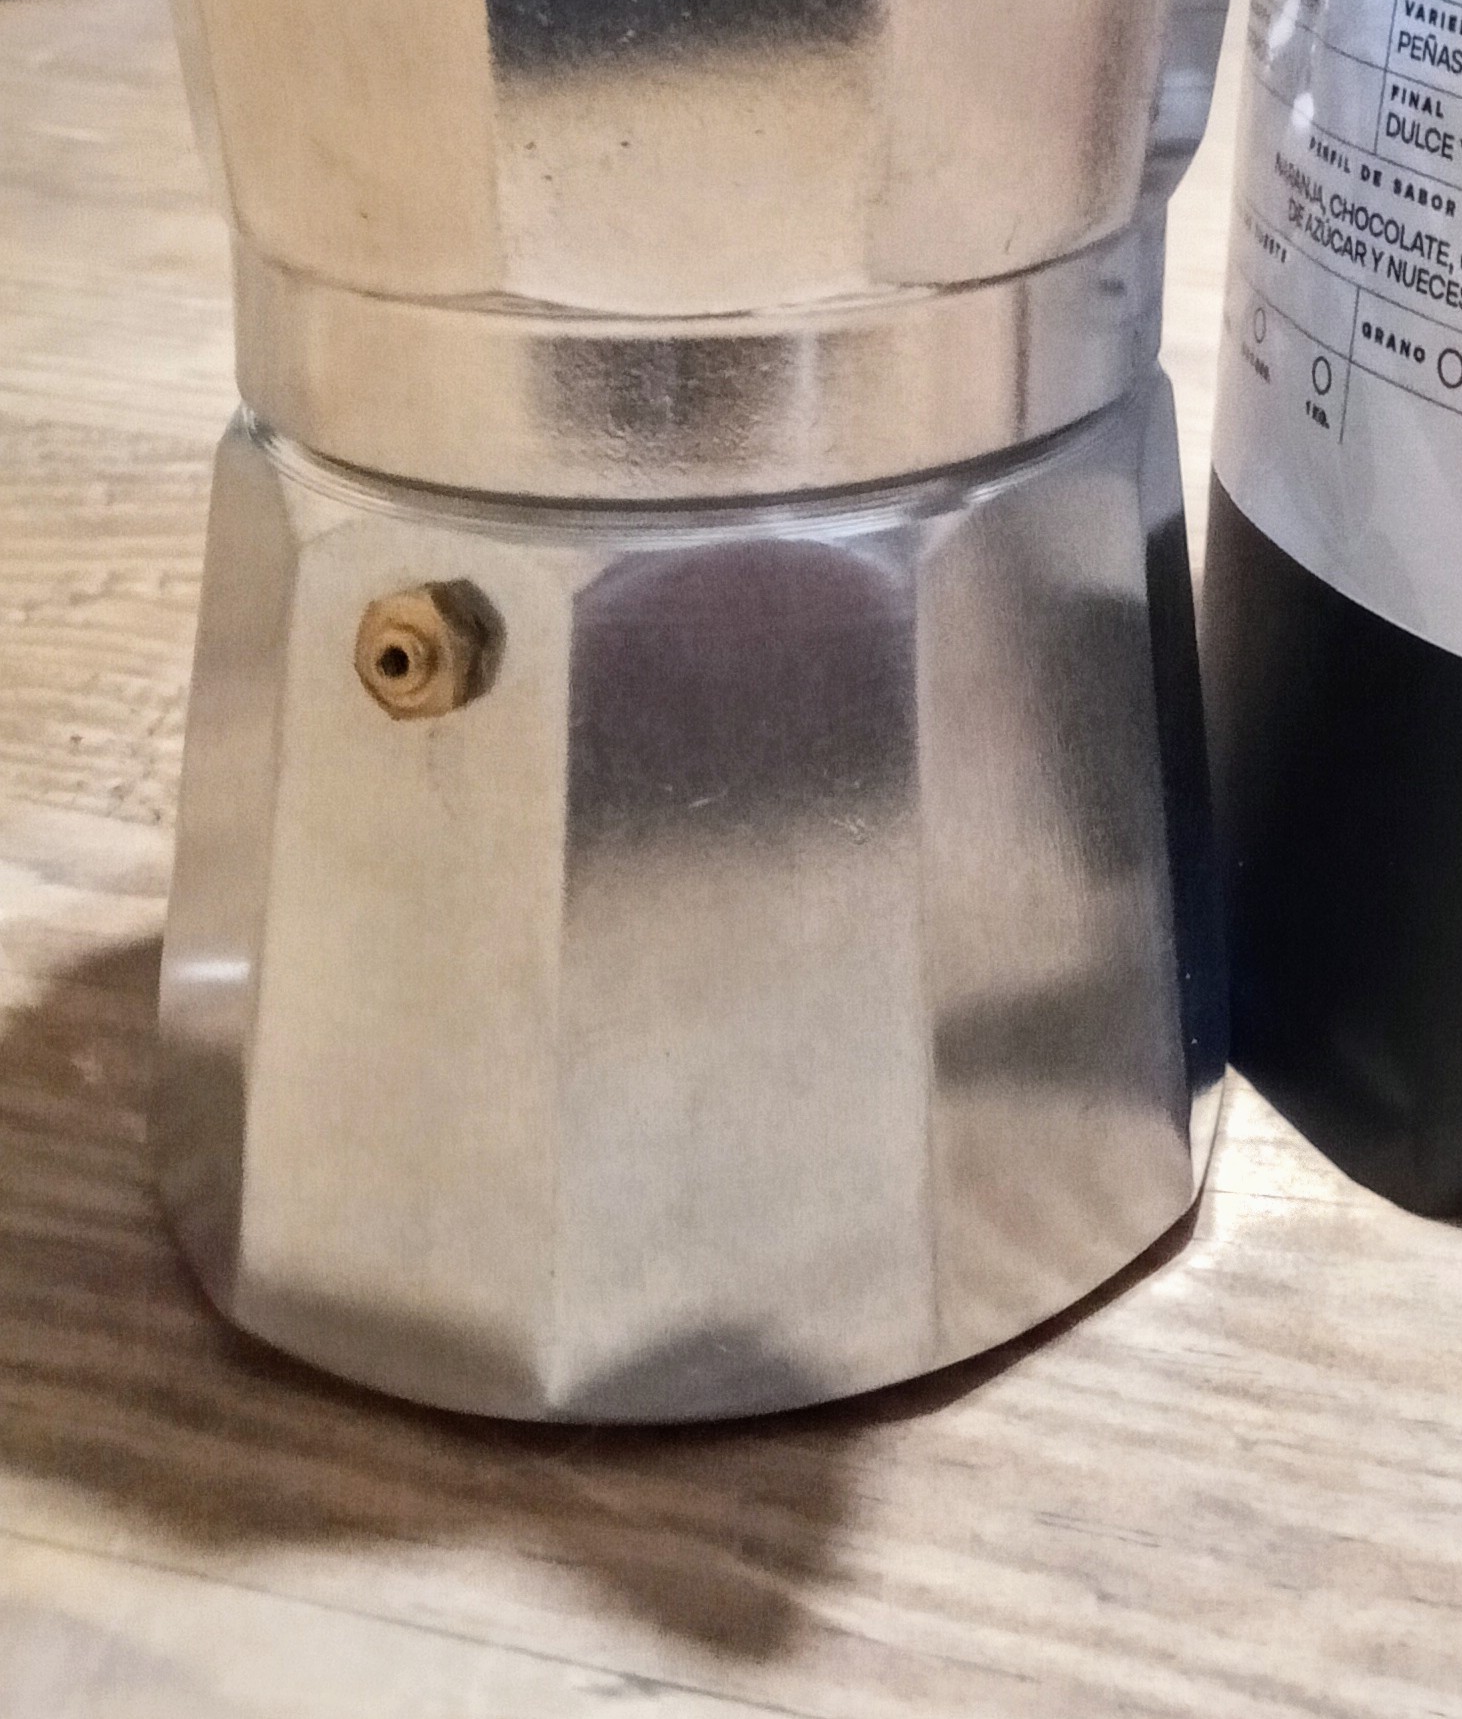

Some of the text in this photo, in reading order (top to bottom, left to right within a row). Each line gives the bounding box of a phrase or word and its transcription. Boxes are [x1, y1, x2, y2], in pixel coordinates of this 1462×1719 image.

[1390, 83, 1445, 120] FINAL
[1385, 111, 1456, 162] DULCE
[1359, 163, 1383, 188] DE
[1392, 177, 1457, 218] SABOR
[1287, 196, 1306, 230] DE
[1371, 246, 1385, 274] Y
[1328, 193, 1454, 275] CHOCOLATE,
[1361, 321, 1426, 364] GRANO
